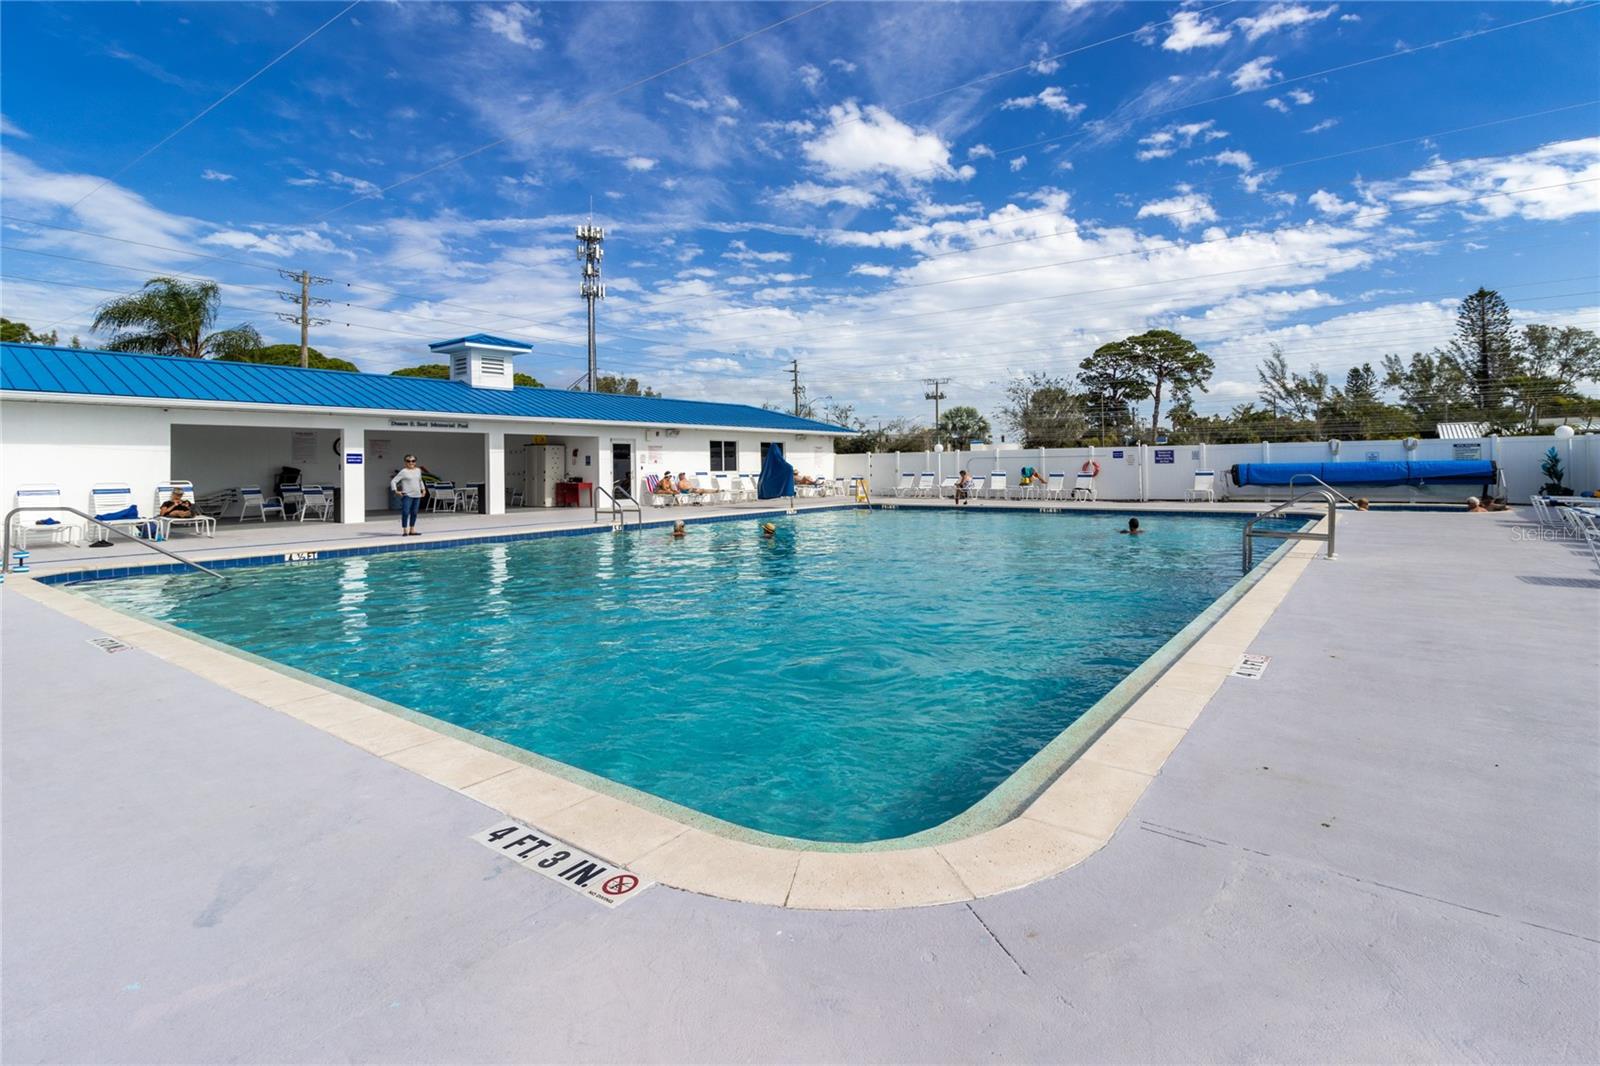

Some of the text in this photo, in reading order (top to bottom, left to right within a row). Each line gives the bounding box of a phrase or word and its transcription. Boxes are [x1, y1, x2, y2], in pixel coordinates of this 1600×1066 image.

[488, 826, 607, 888] 4 FT. 3 IN.
[596, 893, 614, 904] DIVING
